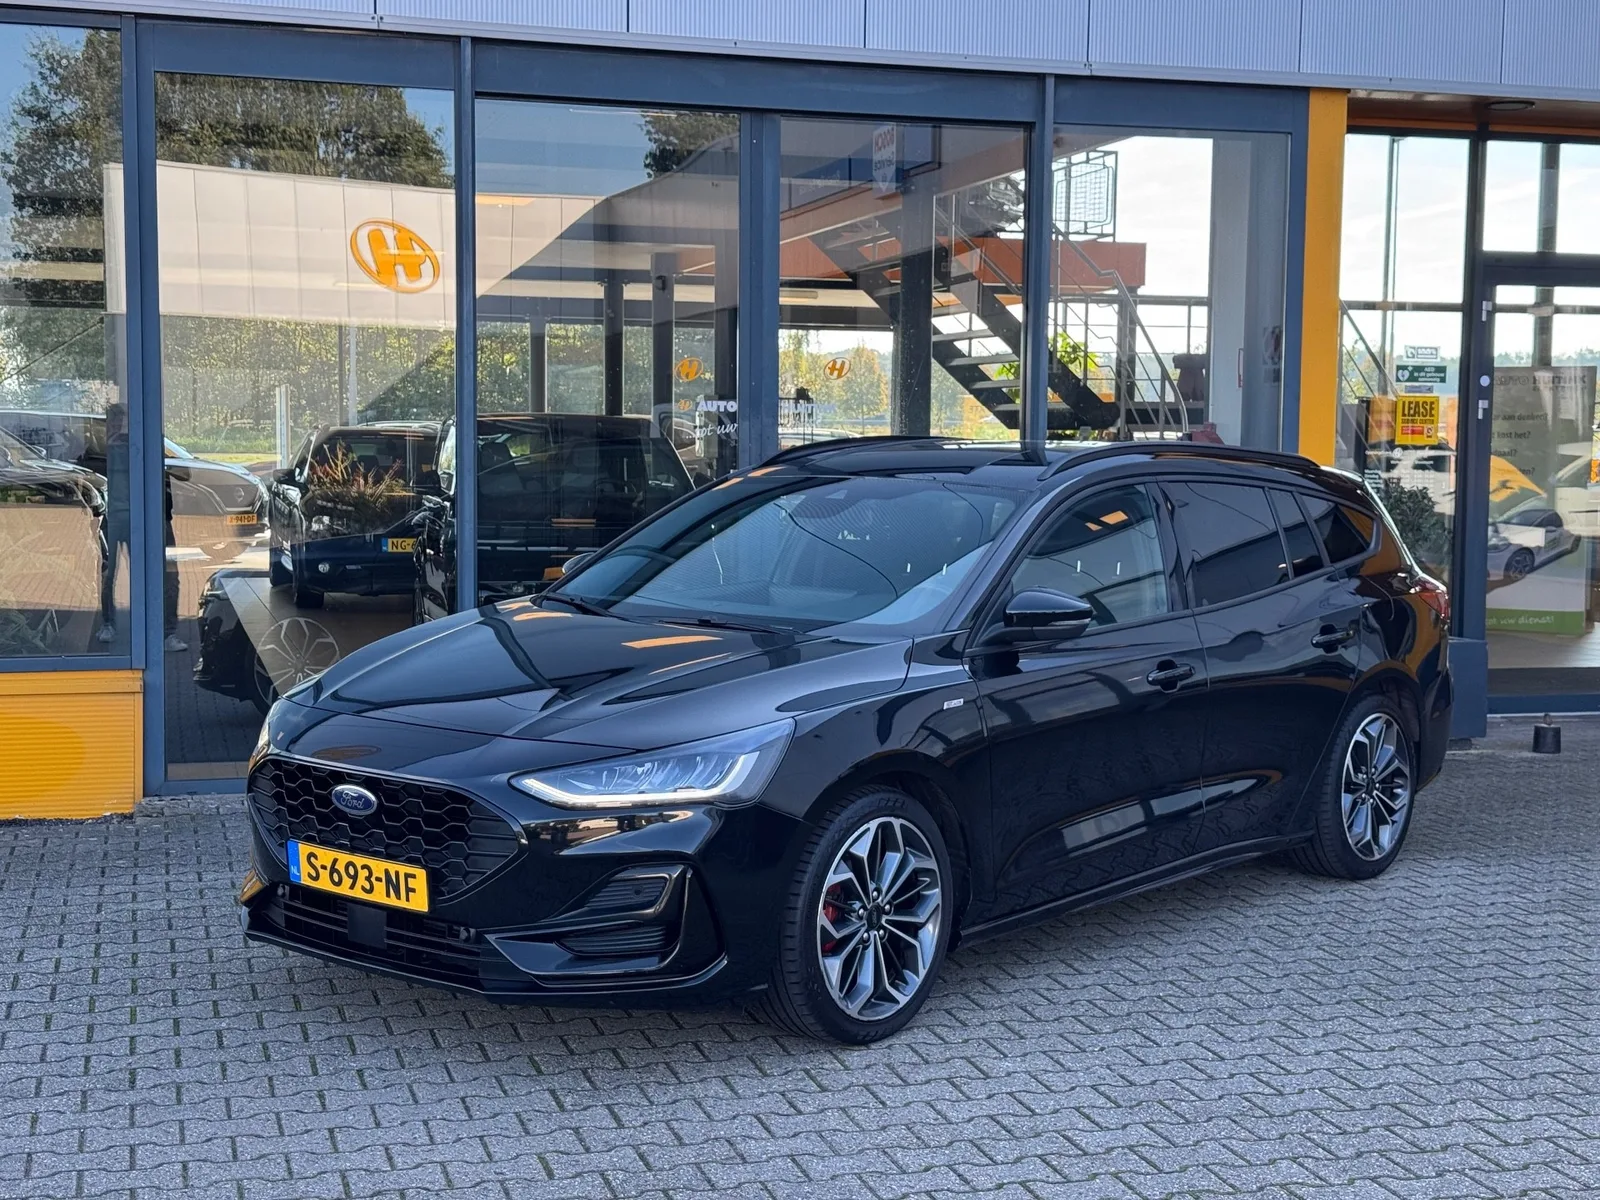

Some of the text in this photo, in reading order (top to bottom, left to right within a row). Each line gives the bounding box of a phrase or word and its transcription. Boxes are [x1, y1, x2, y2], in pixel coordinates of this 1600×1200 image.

[697, 401, 738, 412] AUTO
[1401, 401, 1435, 417] LEASE
[340, 790, 365, 809] Ford
[291, 866, 300, 876] NL
[306, 852, 417, 902] S-693-NF
